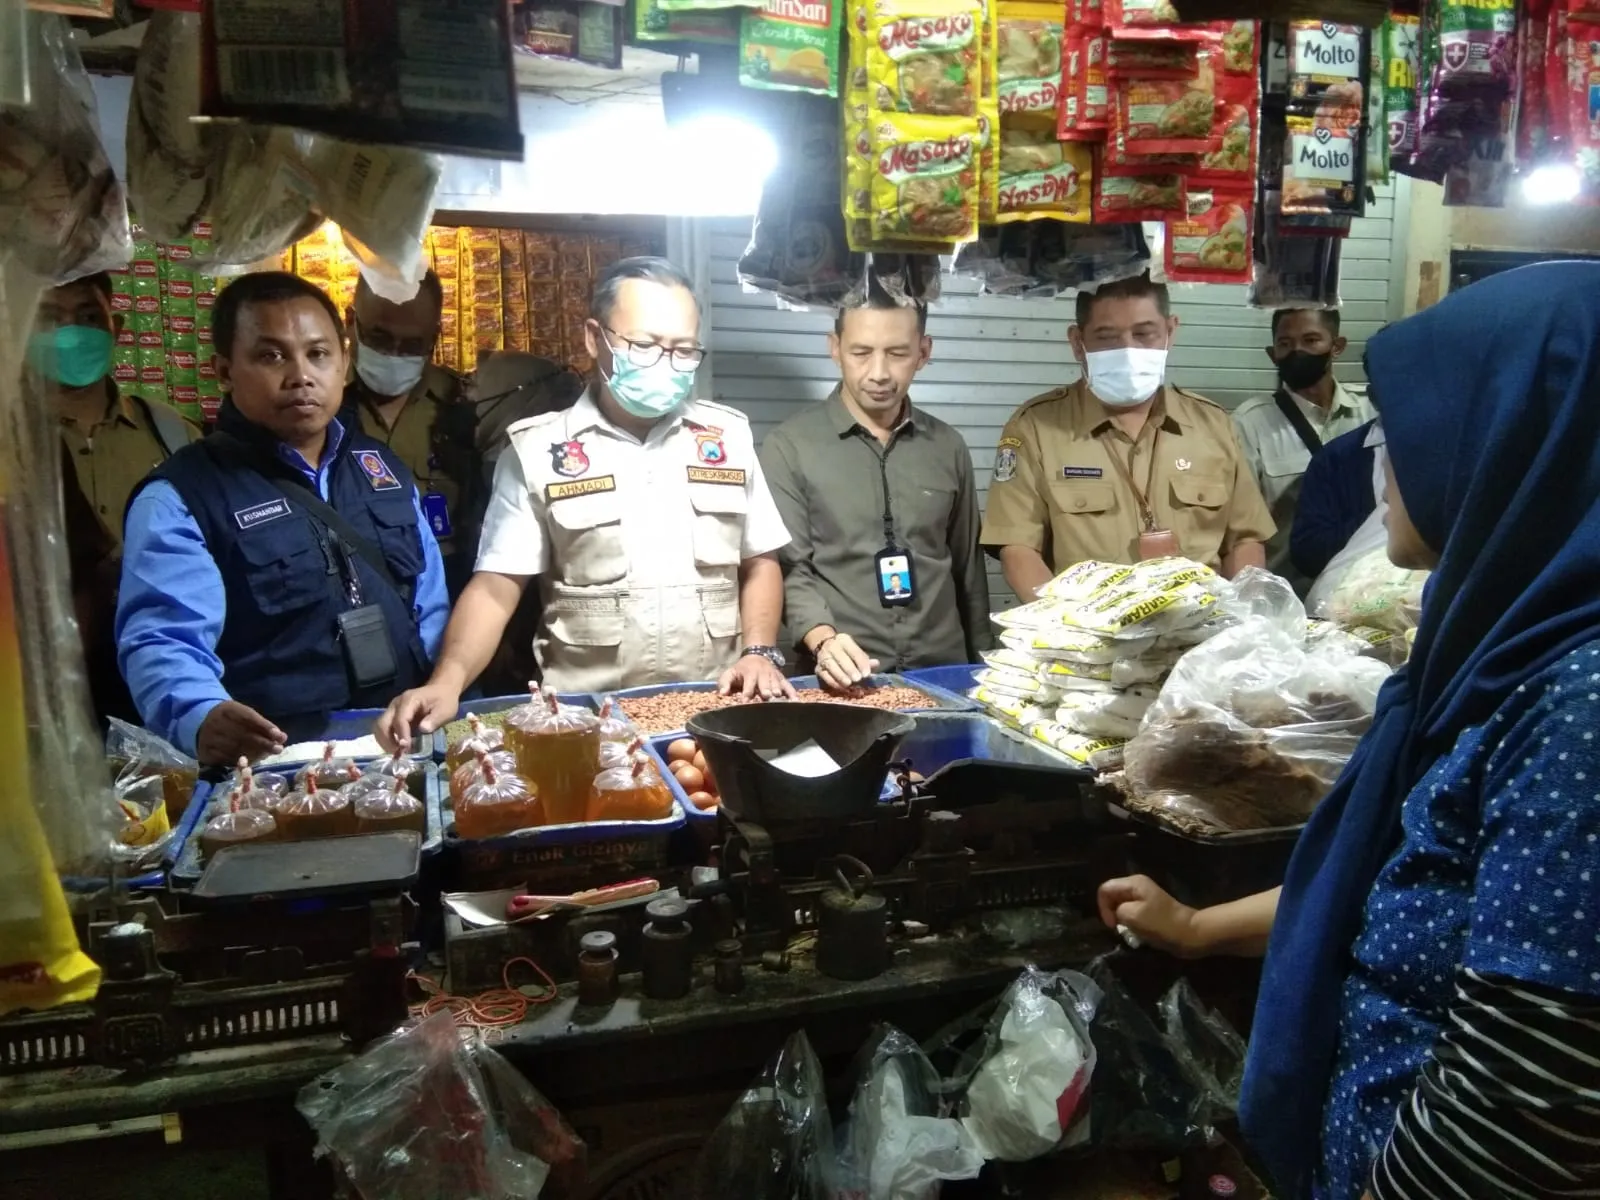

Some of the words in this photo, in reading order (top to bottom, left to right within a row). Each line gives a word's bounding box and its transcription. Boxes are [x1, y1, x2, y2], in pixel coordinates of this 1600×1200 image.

[760, 0, 828, 22] utriSari
[879, 12, 971, 51] Masako
[1303, 40, 1355, 65] Molto
[879, 134, 970, 175] Masako
[1300, 145, 1349, 169] Molto
[999, 171, 1080, 211] Masak
[558, 479, 607, 497] AHMADI
[1119, 595, 1169, 628] GARAM
[512, 846, 564, 865] Enak
